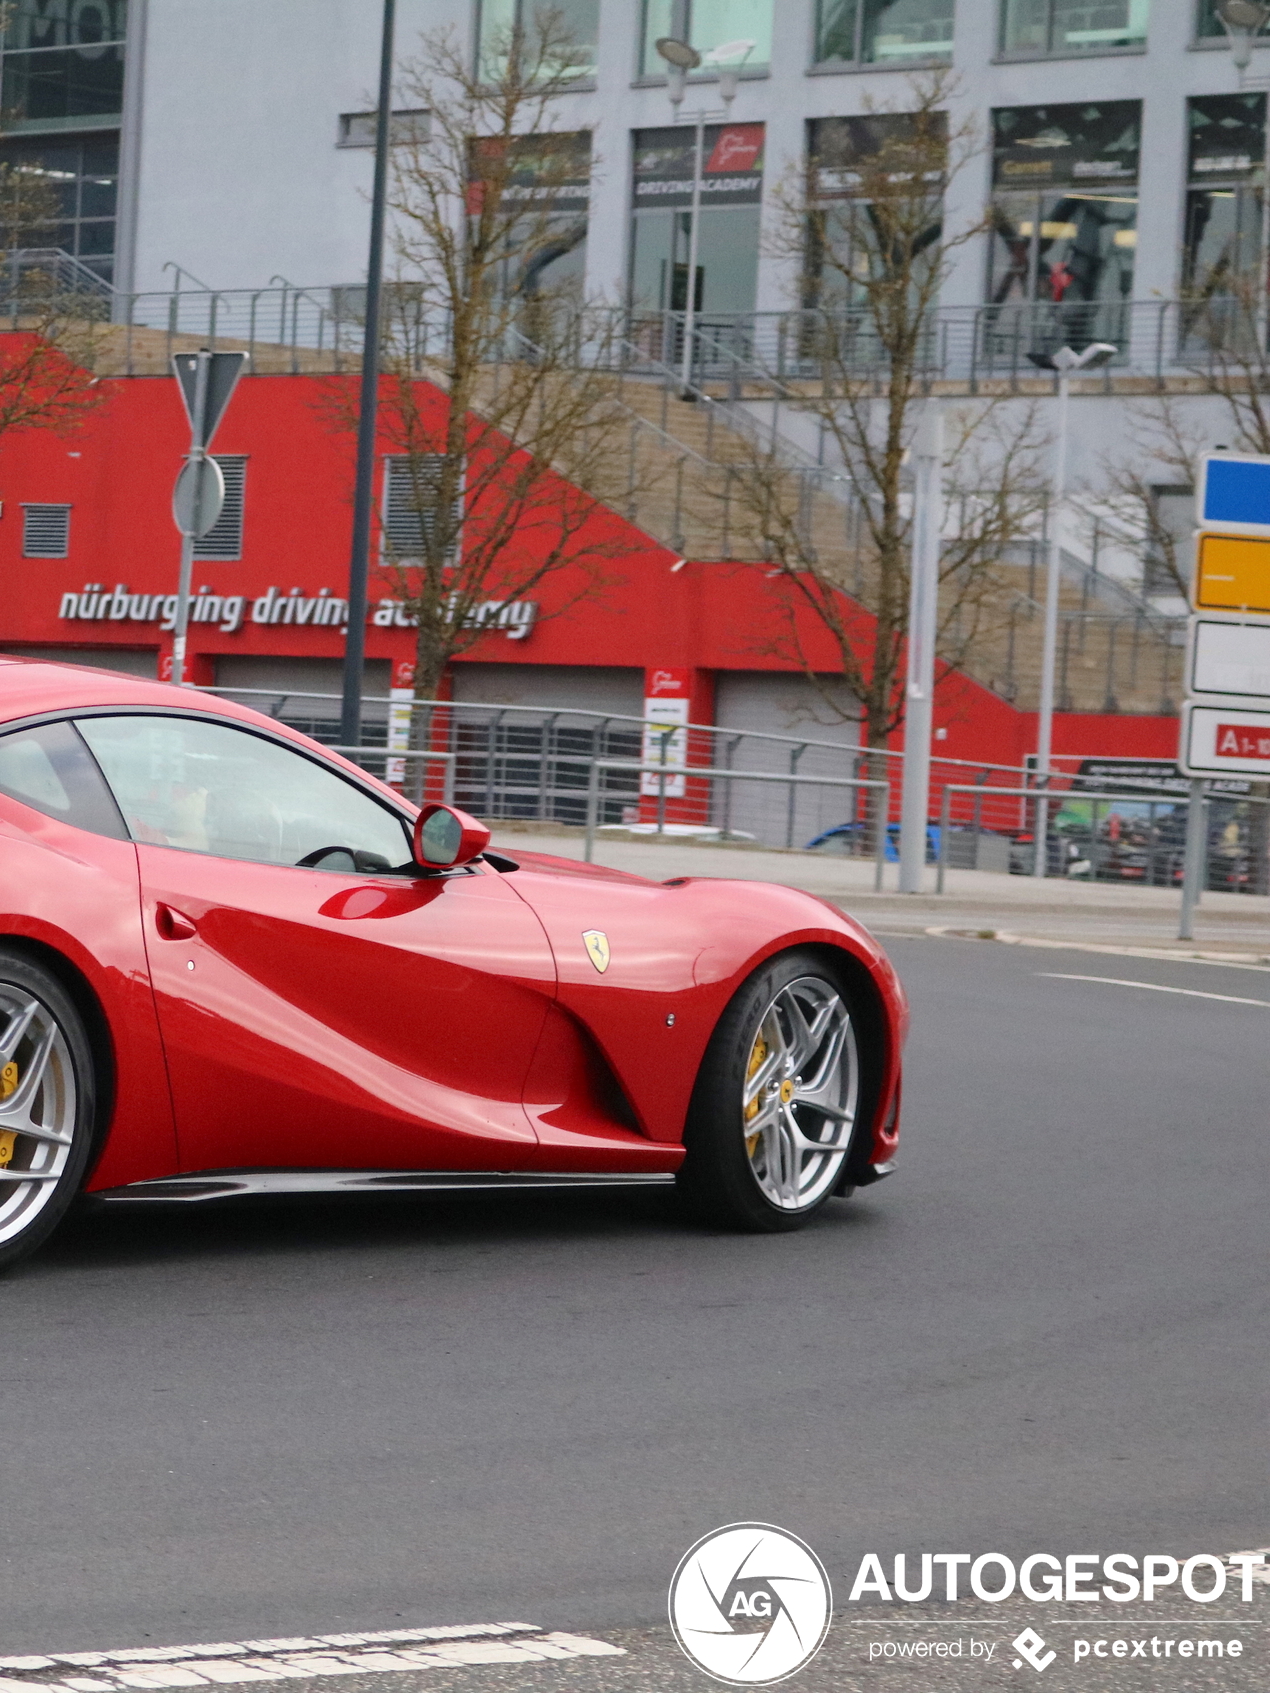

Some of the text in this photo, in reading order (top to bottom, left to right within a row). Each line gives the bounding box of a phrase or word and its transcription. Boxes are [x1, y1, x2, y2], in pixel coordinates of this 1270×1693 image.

[636, 176, 761, 195] DRIVING ACADEMY
[1220, 729, 1239, 753] A
